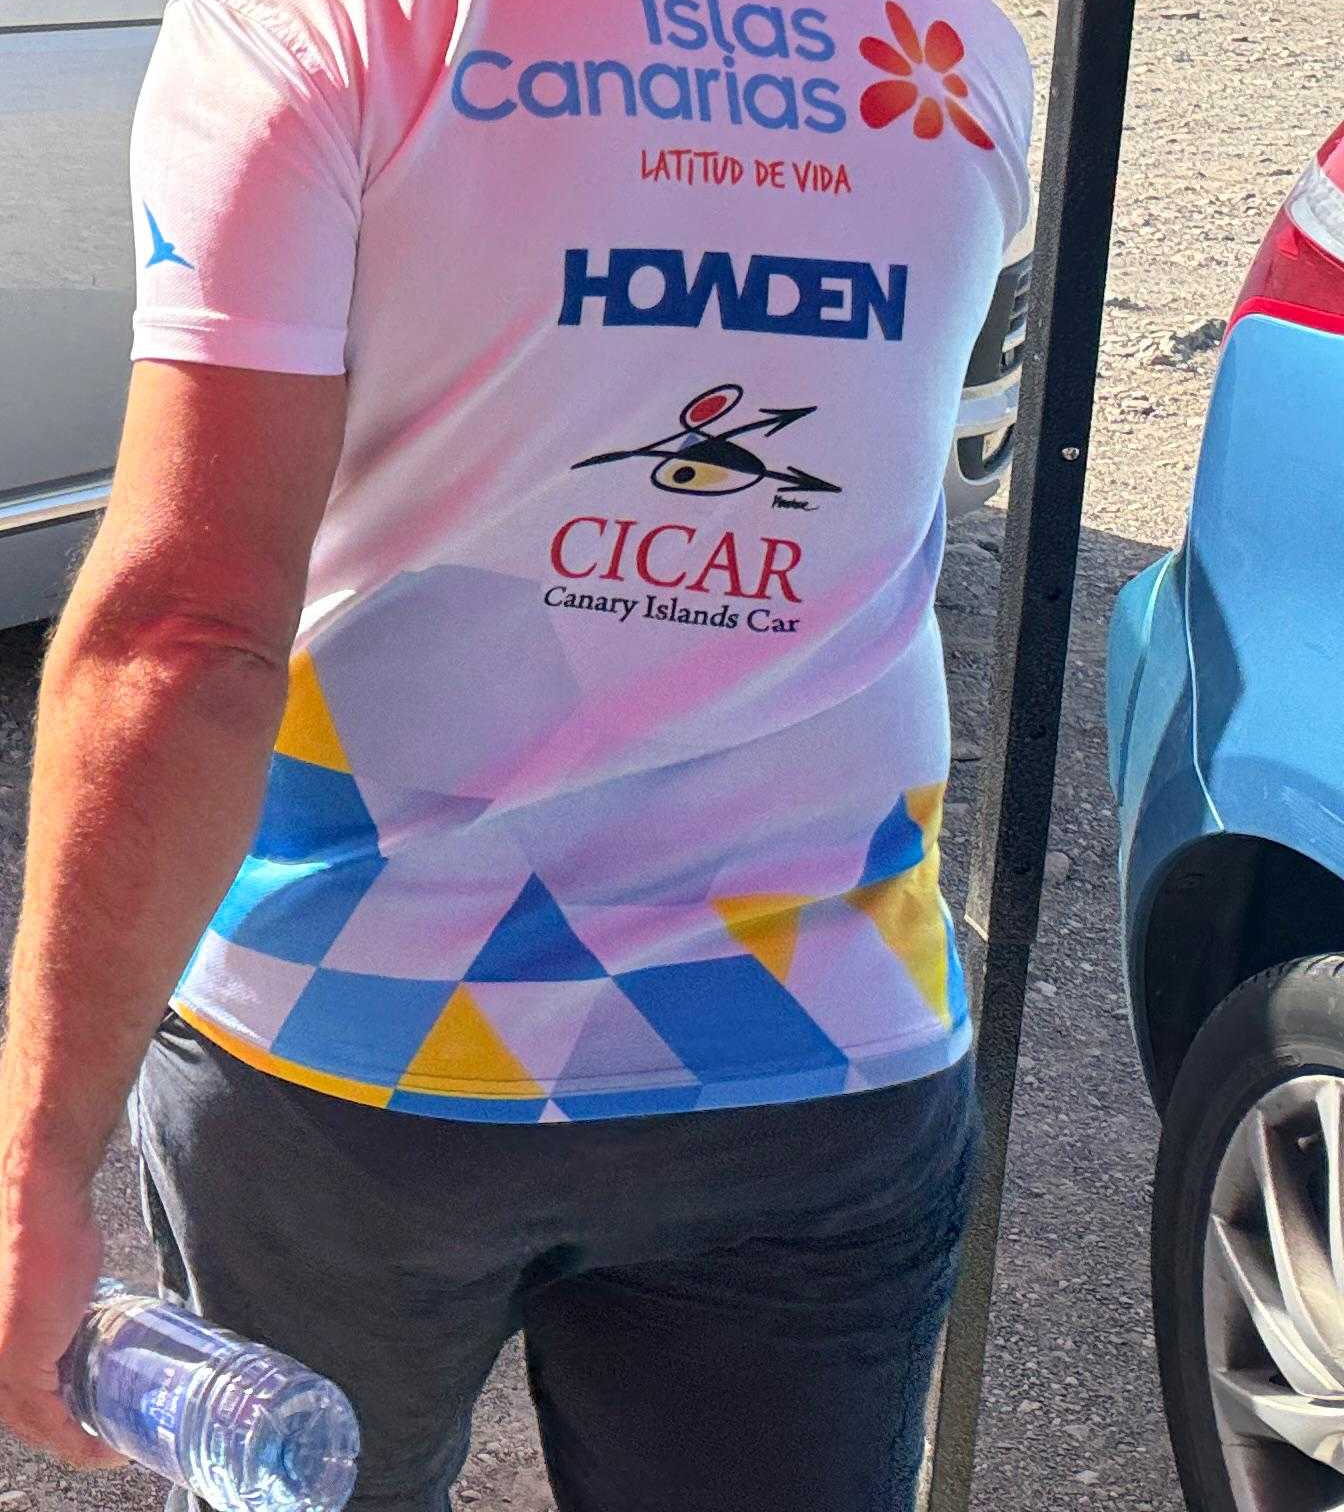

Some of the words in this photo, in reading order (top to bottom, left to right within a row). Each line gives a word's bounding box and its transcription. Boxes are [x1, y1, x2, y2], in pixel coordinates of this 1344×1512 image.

[451, 48, 848, 134] Canarias
[754, 159, 786, 189] DE
[792, 160, 853, 194] VIDA
[558, 248, 909, 342] HOWDEN
[549, 515, 803, 604] CICAR
[543, 585, 638, 623] Canary
[642, 594, 740, 629] Islands
[746, 608, 801, 633] Car
